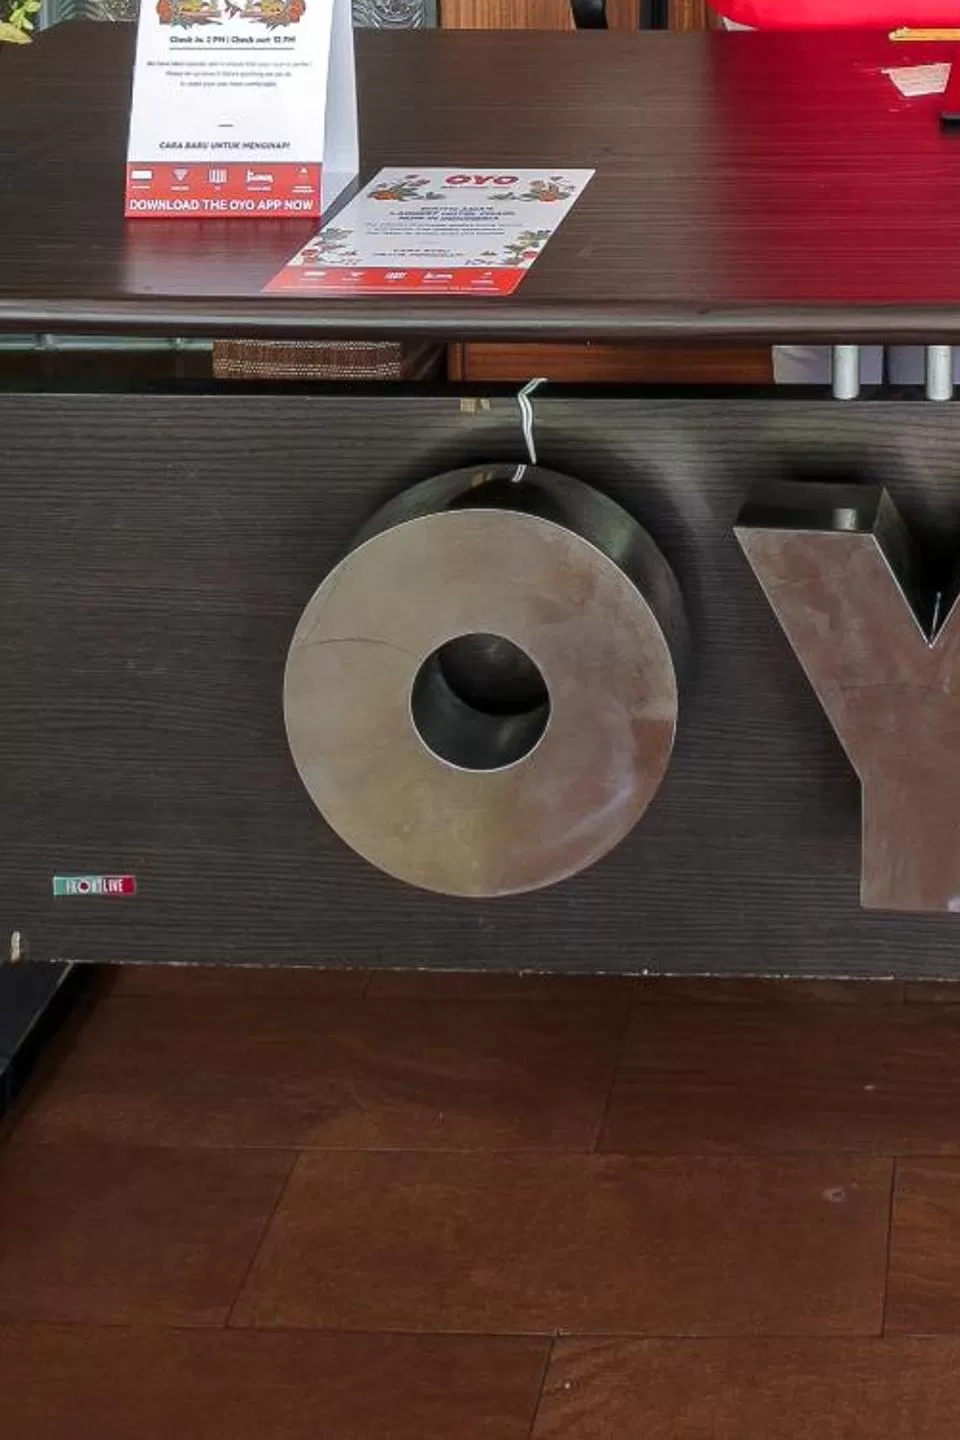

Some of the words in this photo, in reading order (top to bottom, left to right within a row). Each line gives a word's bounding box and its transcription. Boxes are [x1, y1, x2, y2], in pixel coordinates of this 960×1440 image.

[445, 175, 519, 185] OYO
[129, 199, 200, 211] DOWNLOAD
[203, 199, 227, 211] THE
[230, 199, 254, 211] OYO
[257, 199, 281, 210] APP
[284, 199, 313, 210] NOW
